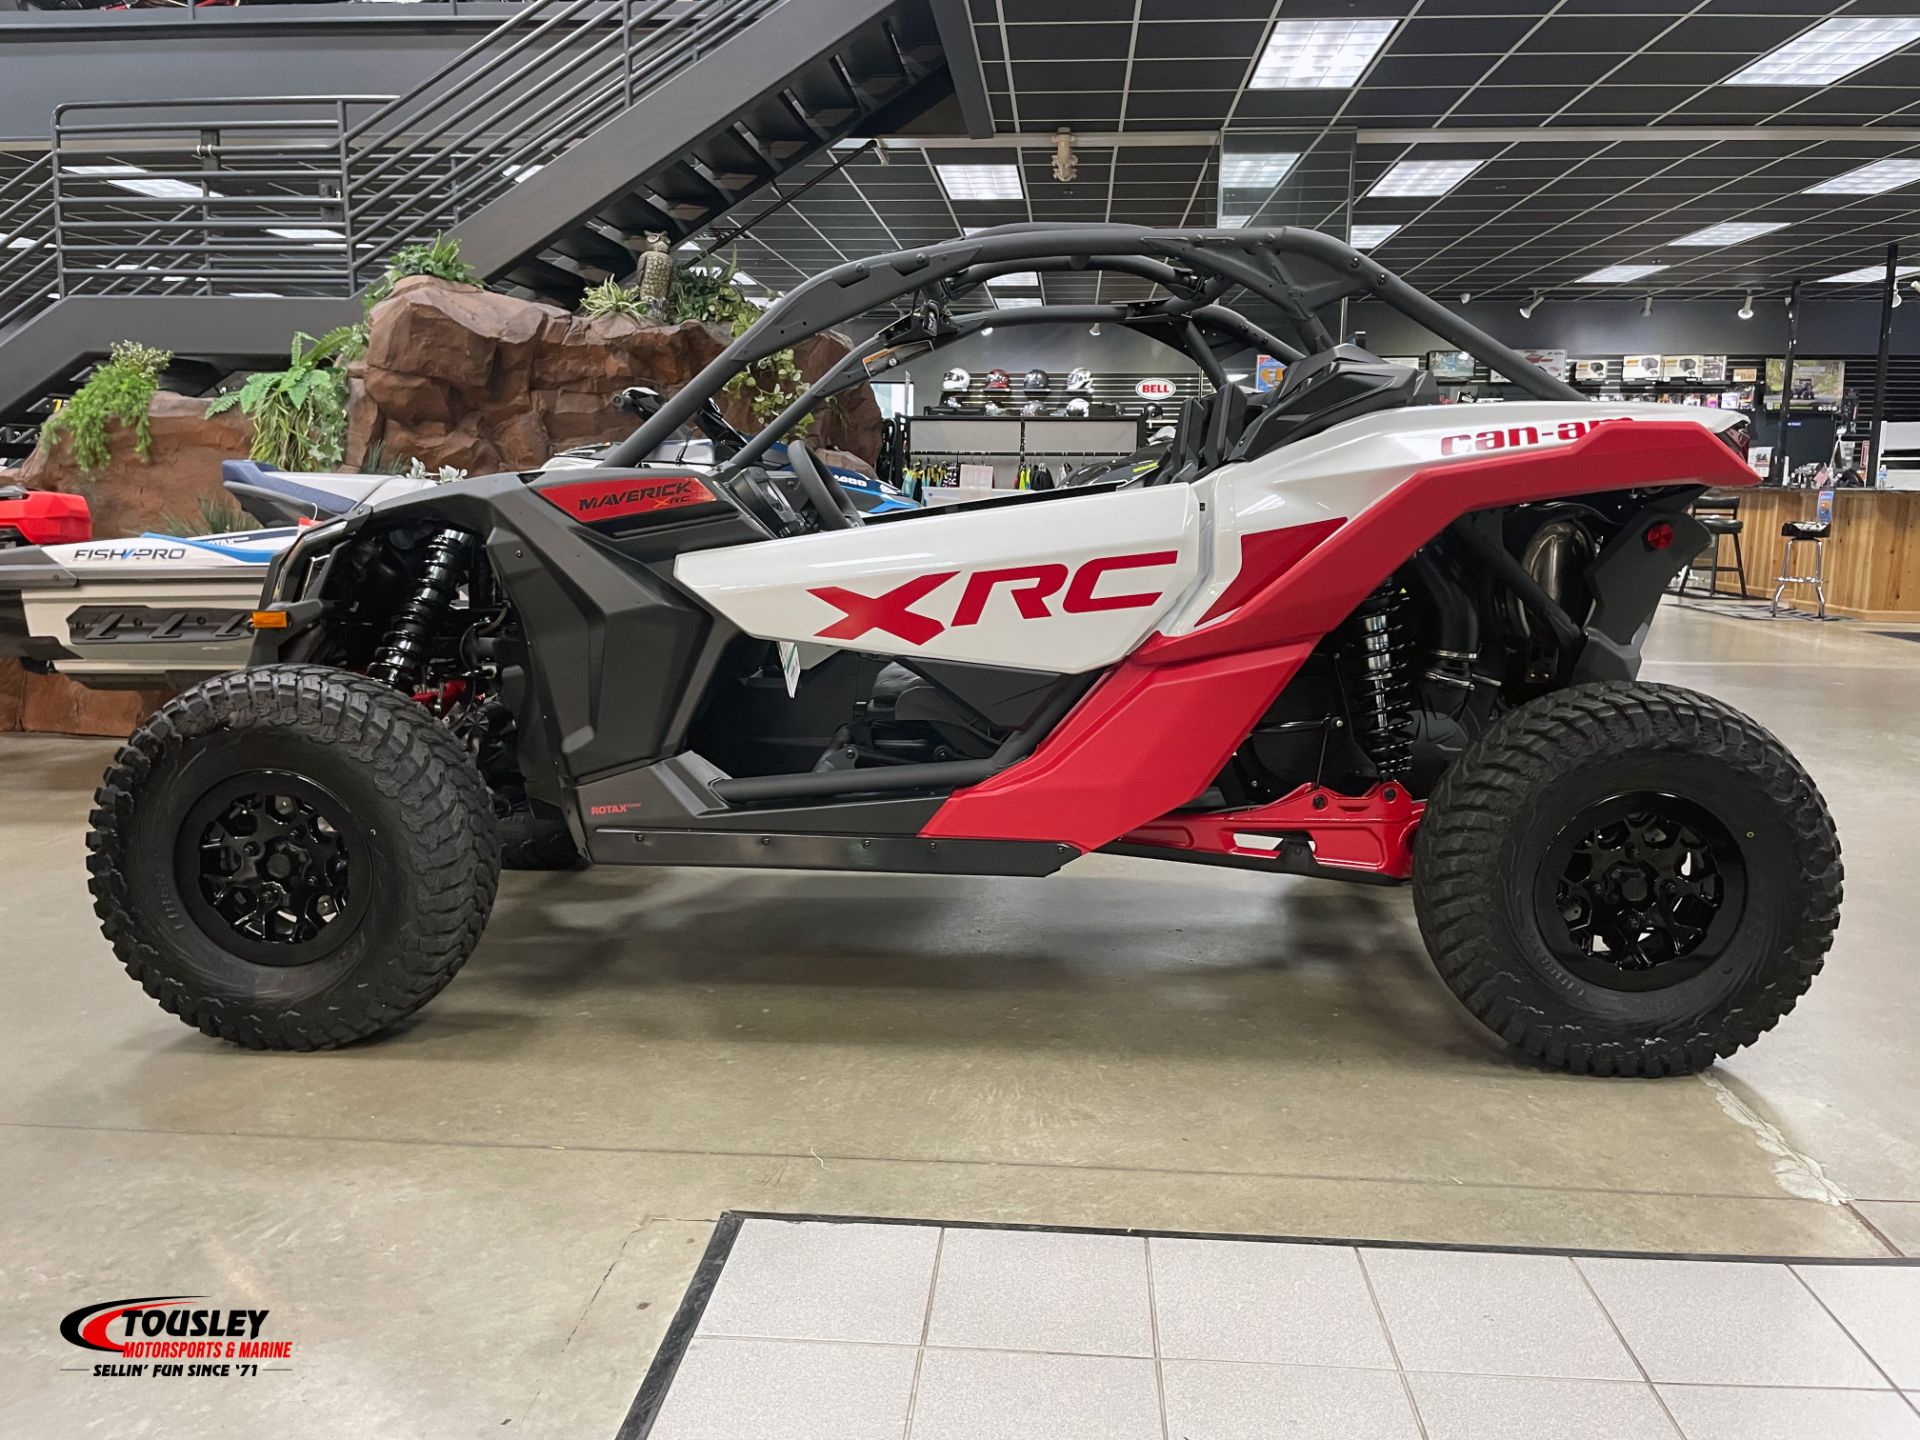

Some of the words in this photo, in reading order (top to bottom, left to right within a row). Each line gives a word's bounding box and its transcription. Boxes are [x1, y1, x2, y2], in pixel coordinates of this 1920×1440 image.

[1142, 384, 1169, 393] BELL
[1441, 417, 1633, 456] can-a
[579, 481, 692, 511] MAVERICK
[654, 495, 690, 509] XRC
[806, 550, 1178, 645] XRC
[591, 803, 628, 815] ROTAX
